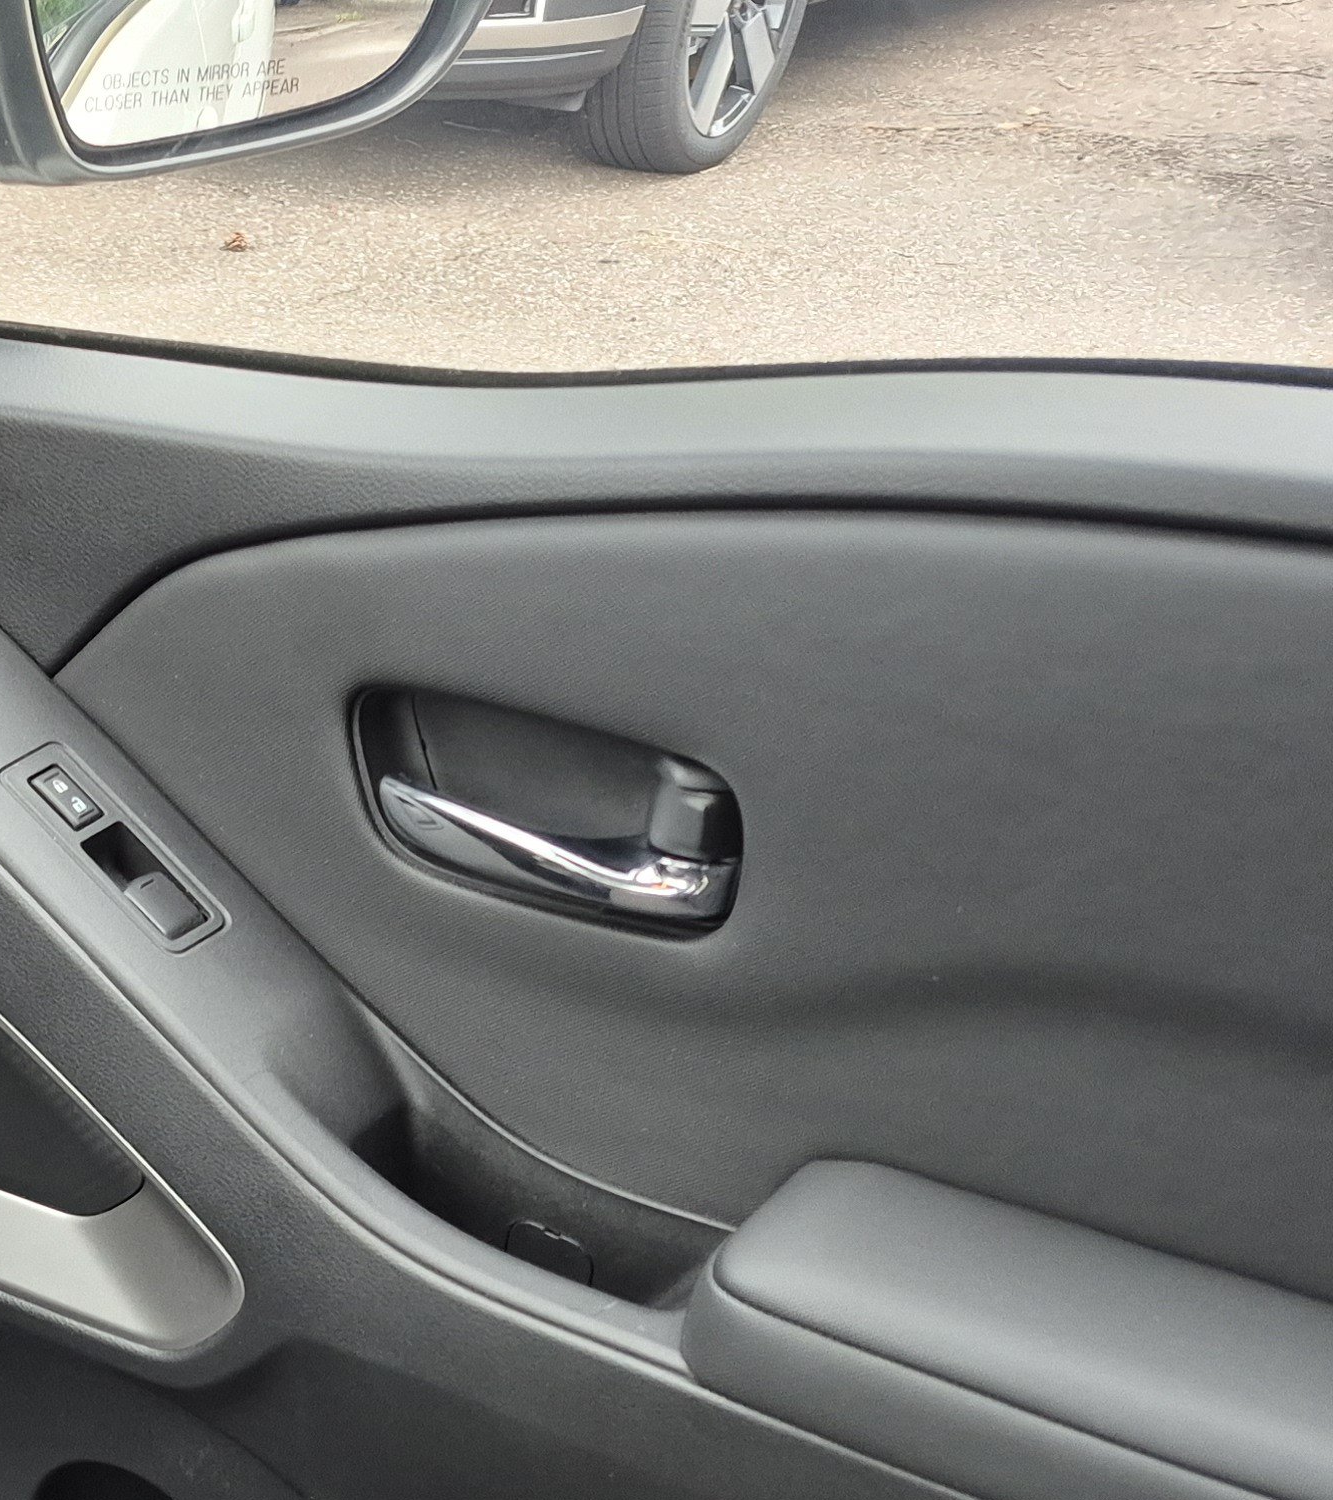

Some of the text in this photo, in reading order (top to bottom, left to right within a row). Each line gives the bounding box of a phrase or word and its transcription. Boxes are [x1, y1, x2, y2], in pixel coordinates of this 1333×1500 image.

[103, 58, 286, 91] OBJECTS IN MIRROR ARE
[84, 77, 300, 112] CLOSER THAN THEY APPEAR
